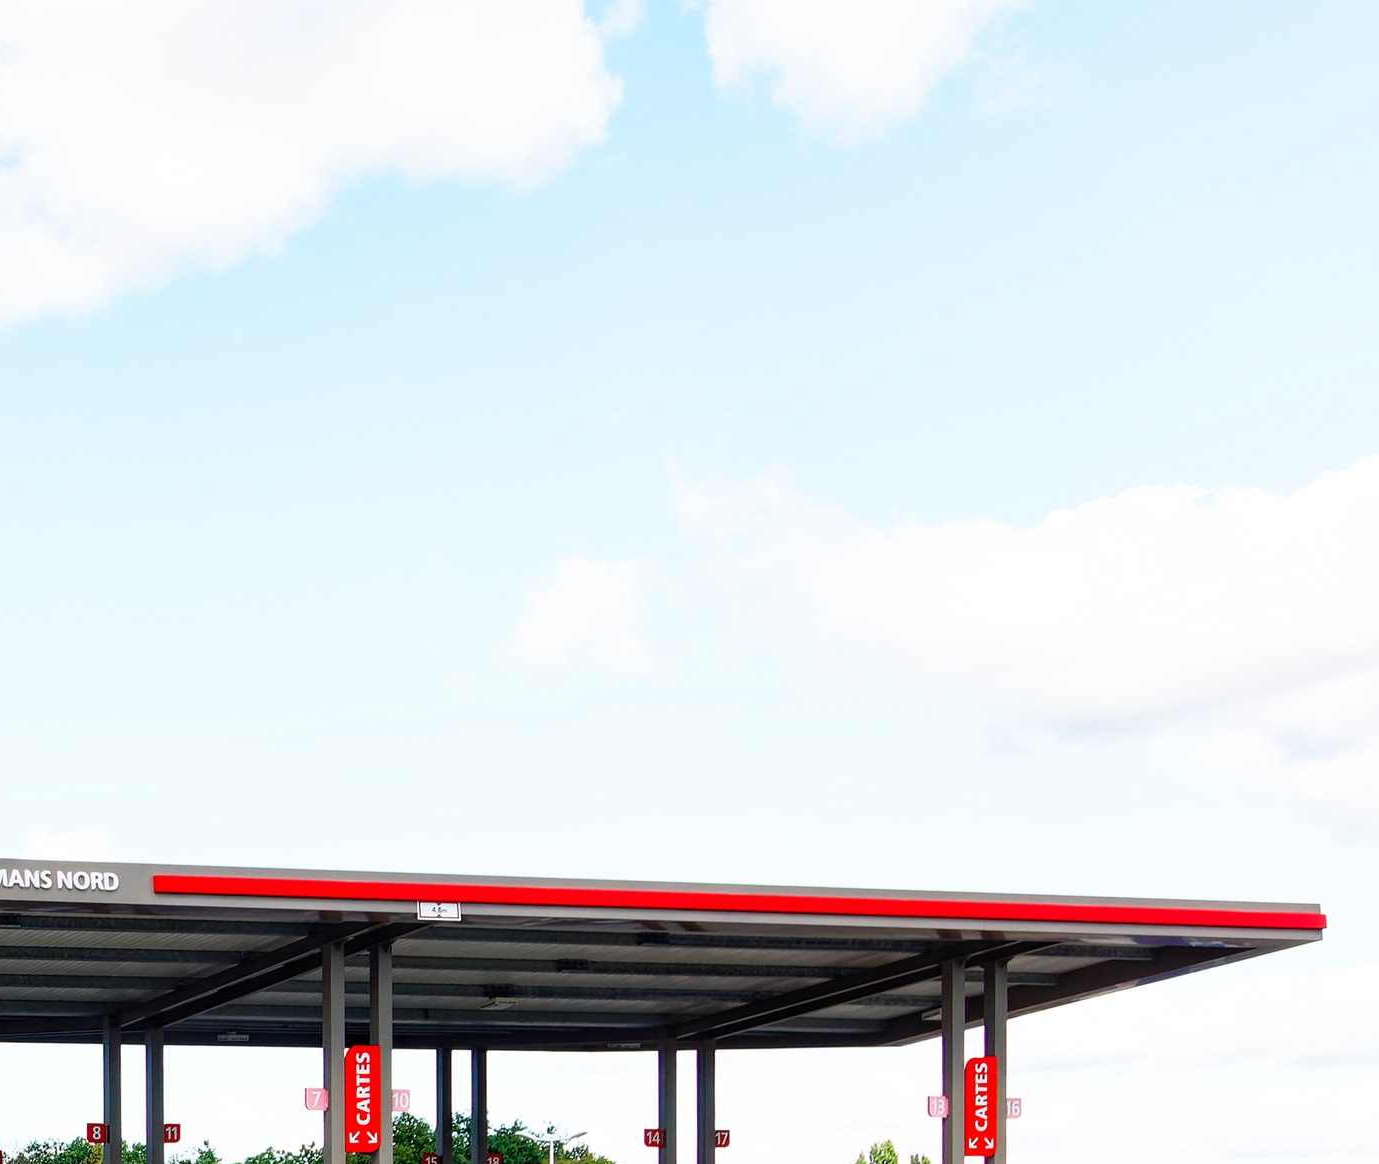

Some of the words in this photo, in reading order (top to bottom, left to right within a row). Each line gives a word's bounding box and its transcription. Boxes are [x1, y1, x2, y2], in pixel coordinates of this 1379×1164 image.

[57, 870, 120, 891] NORD
[355, 1052, 370, 1126] CARTES
[974, 1062, 988, 1132] CARTES
[311, 1091, 322, 1107] 7
[392, 1092, 409, 1108] 10
[92, 1126, 102, 1140] 8
[164, 1126, 178, 1139] 11
[646, 1131, 661, 1145] 14
[715, 1132, 728, 1145] 17
